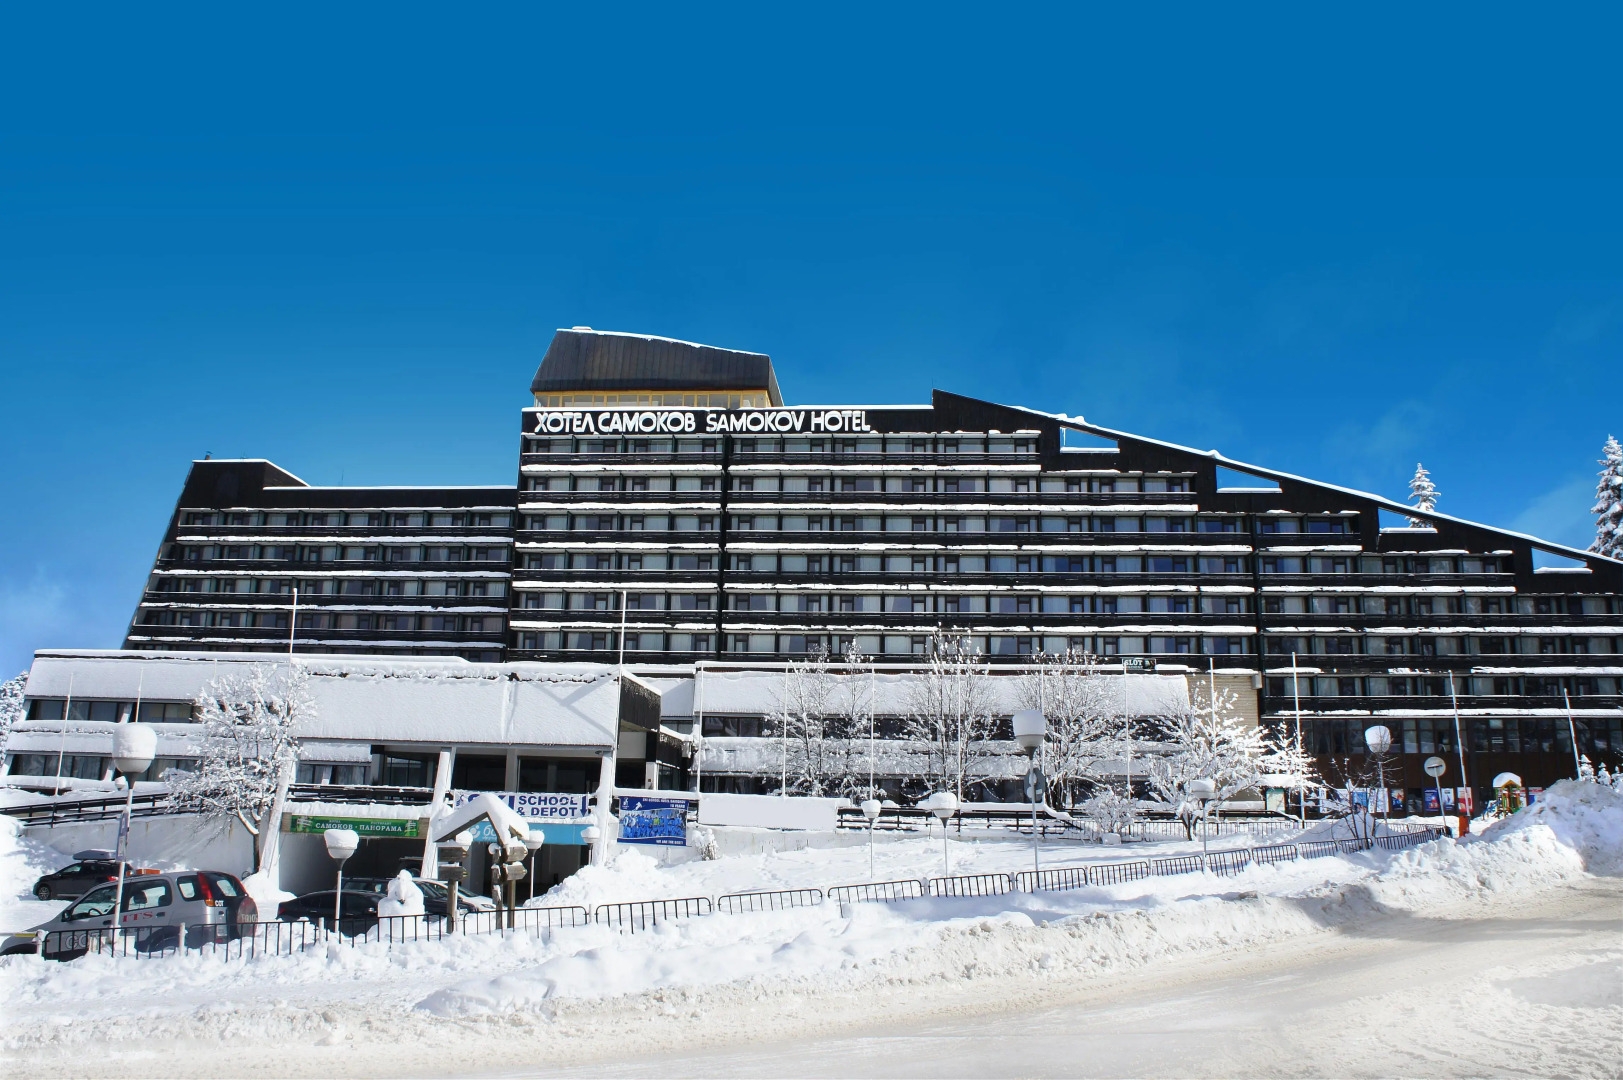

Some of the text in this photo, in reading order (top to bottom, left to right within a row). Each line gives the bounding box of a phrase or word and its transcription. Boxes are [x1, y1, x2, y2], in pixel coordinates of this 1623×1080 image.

[534, 412, 696, 433] ХОТЕЛ САМОКОВ
[705, 411, 871, 432] SAMOKOV HOTEL
[518, 795, 578, 806] SCHOOL
[516, 806, 578, 817] & DEPOT
[315, 822, 353, 830] САМОКОВ
